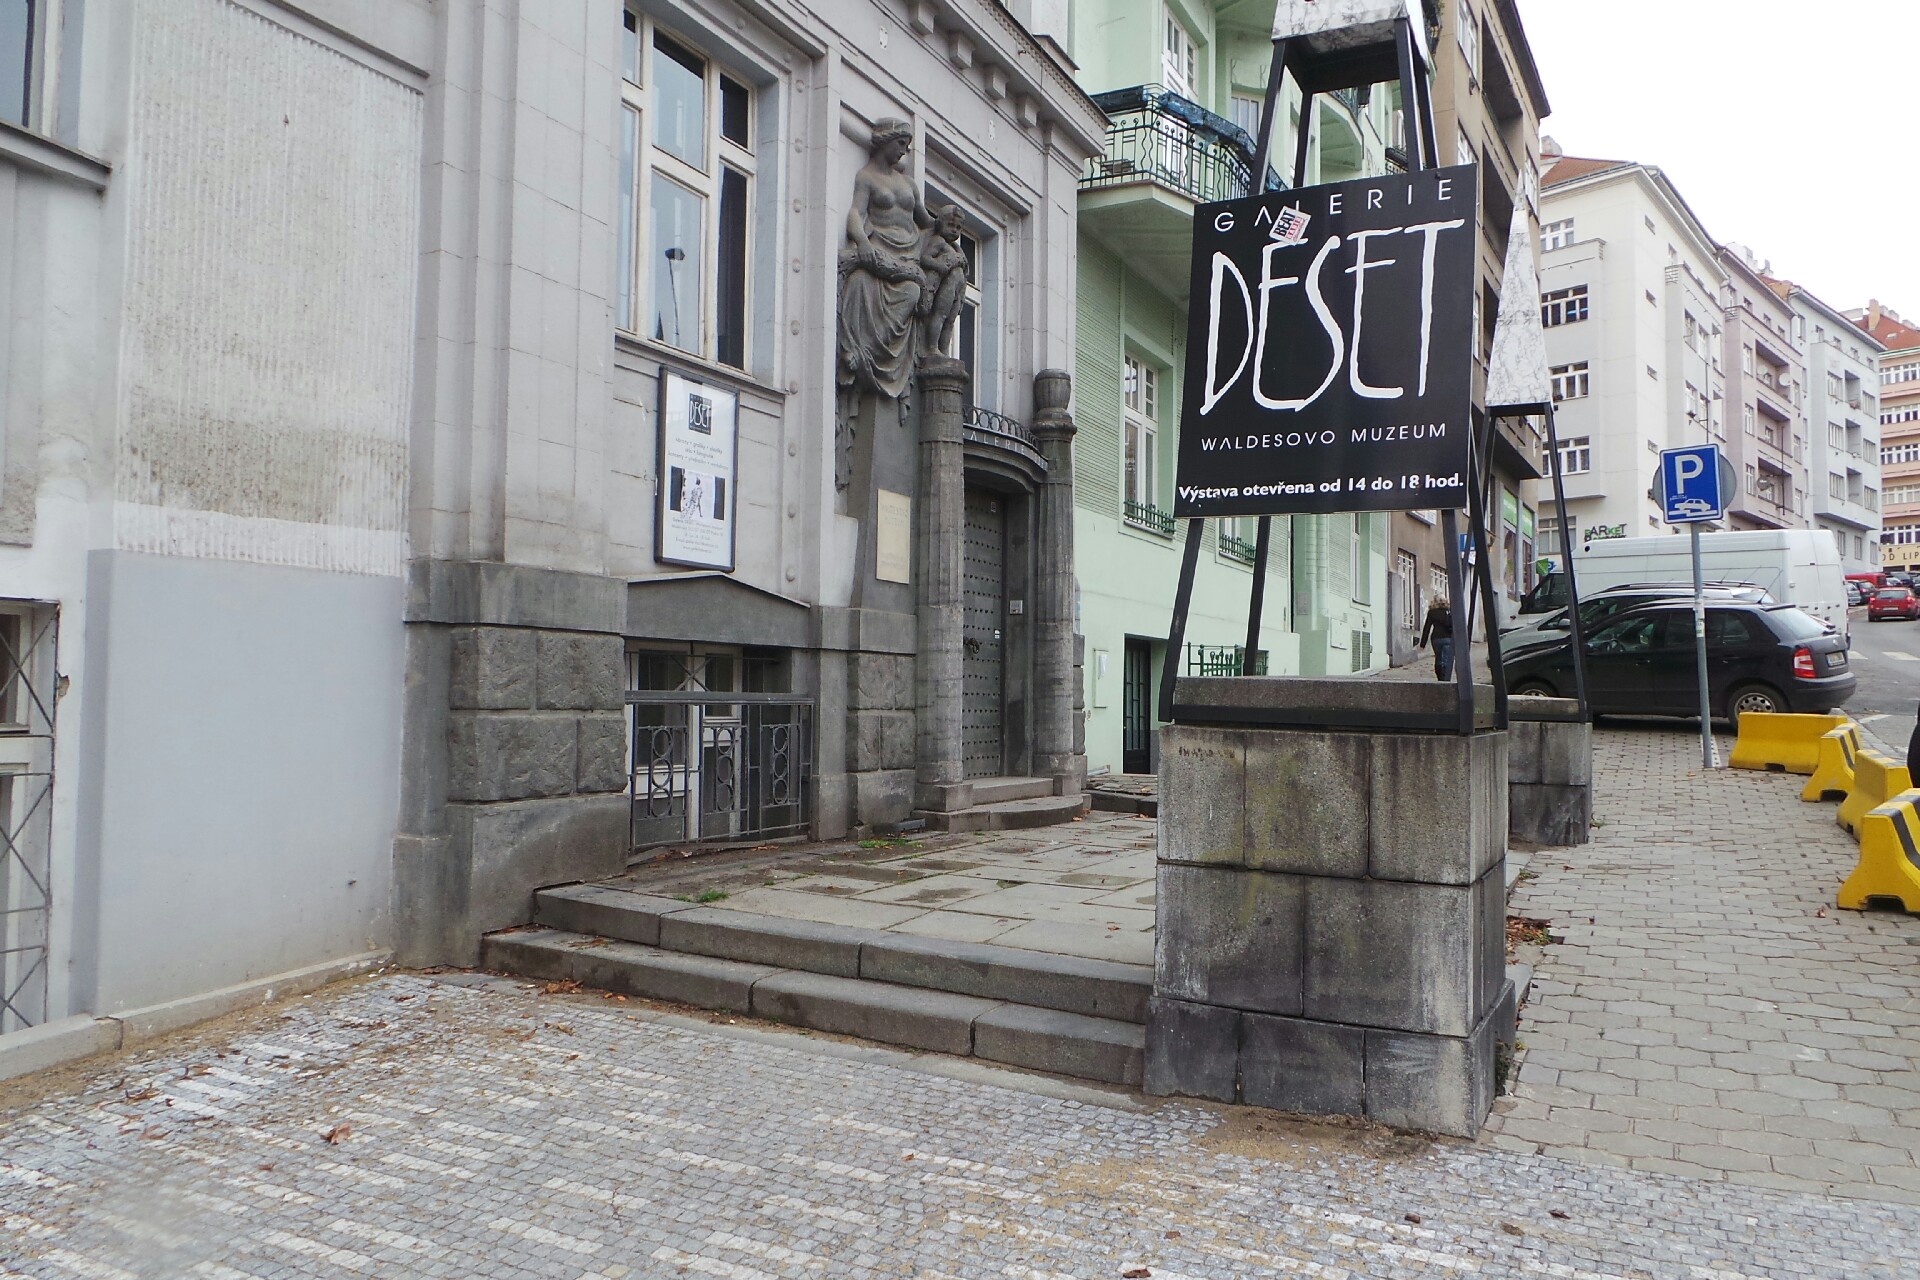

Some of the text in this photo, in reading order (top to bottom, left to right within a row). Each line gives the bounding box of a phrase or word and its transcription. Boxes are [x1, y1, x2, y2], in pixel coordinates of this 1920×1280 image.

[1273, 210, 1296, 237] BEAT
[1200, 219, 1465, 415] DESET
[1201, 423, 1446, 451] WALDESOVO MUZEUM
[1178, 473, 1464, 502] Výstava otevřena od 14 do 18 hod.
[1675, 454, 1704, 494] P
